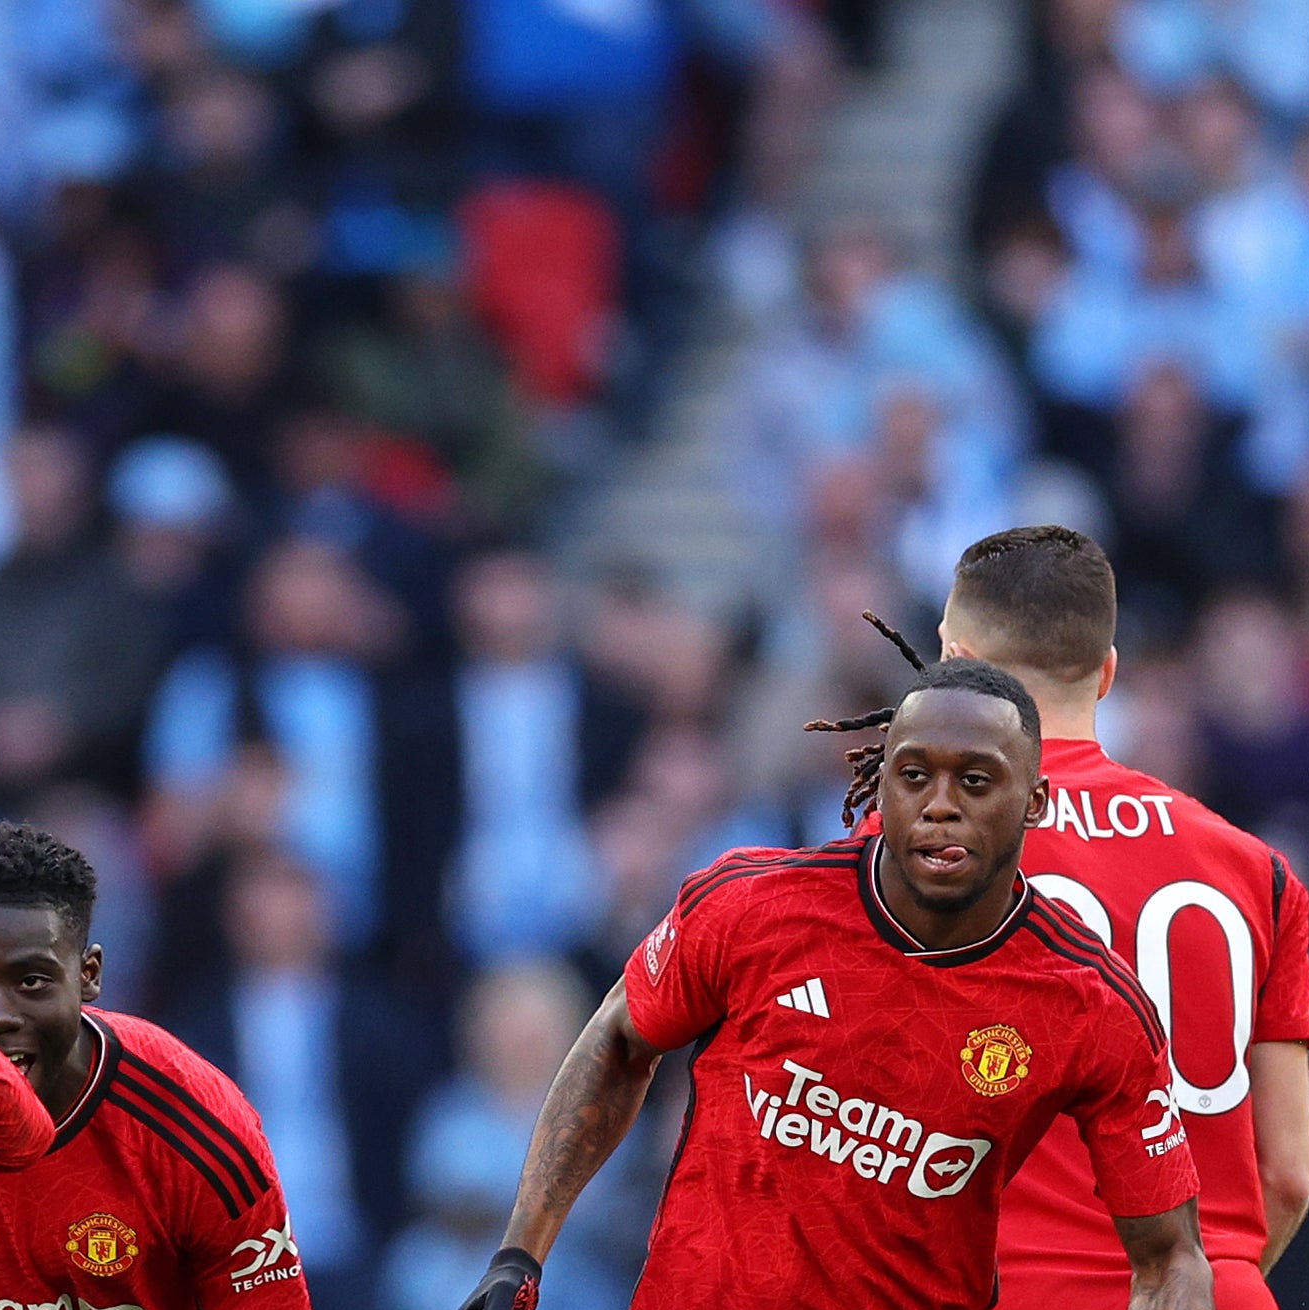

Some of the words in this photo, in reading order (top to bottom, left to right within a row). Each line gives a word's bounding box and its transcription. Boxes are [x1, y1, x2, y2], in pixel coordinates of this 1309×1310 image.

[972, 1029, 1027, 1060] MANCHESTER
[970, 1074, 1007, 1092] UNITED
[782, 1058, 923, 1153] Team
[1141, 1083, 1181, 1140] DX
[744, 1072, 910, 1184] Viewer
[74, 1217, 132, 1240] MANCHESTER
[231, 1209, 298, 1280] DX
[83, 1261, 123, 1272] UNITED
[232, 1265, 301, 1293] TECHNO
